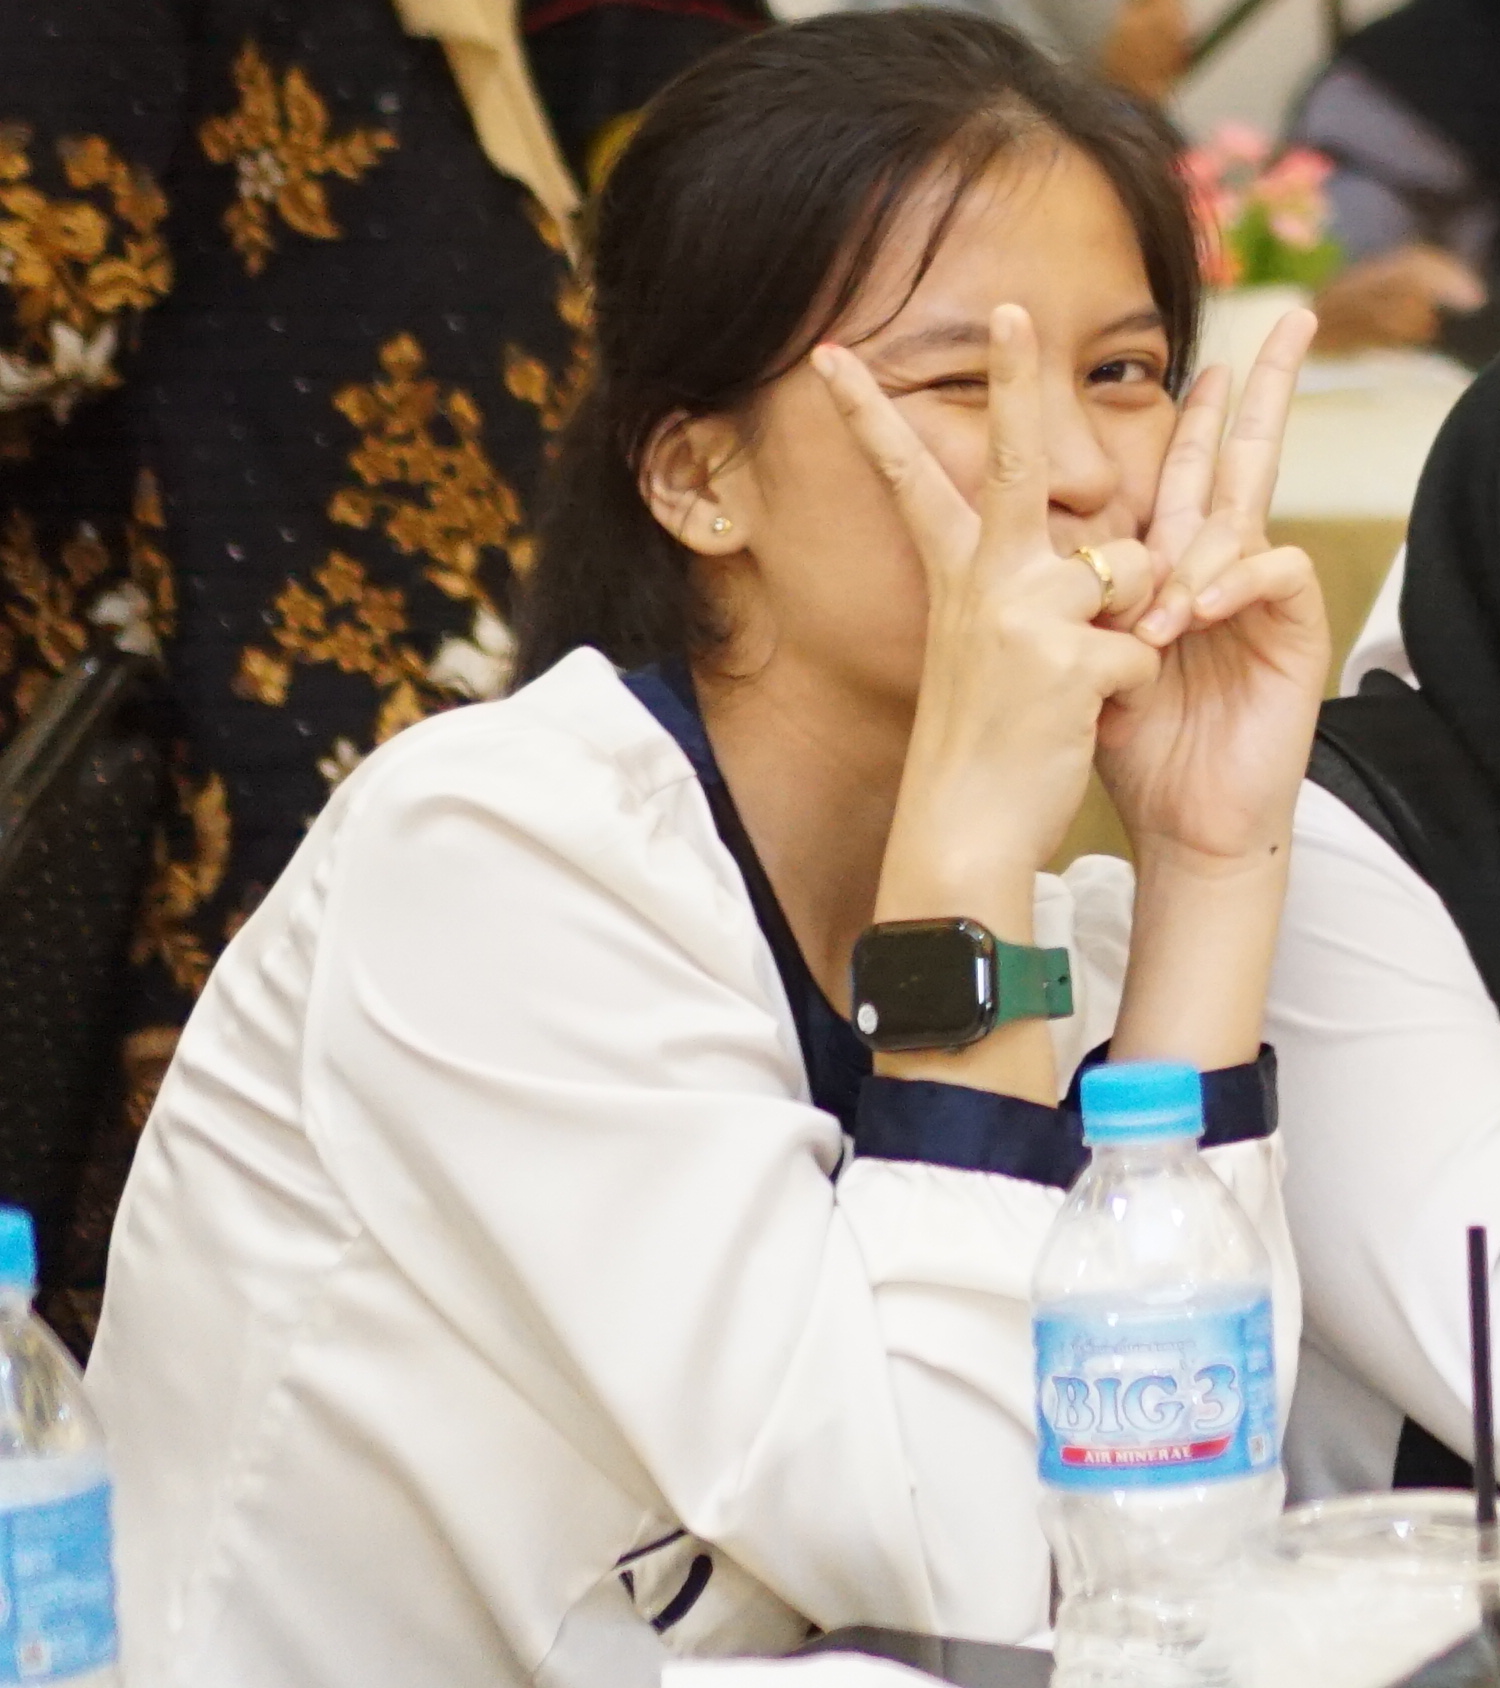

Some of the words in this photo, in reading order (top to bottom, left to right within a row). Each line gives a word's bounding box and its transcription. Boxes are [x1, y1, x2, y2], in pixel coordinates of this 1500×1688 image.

[1052, 1375, 1185, 1433] BIG
[1192, 1364, 1241, 1431] 3
[1084, 1450, 1111, 1464] AIR
[1115, 1446, 1193, 1464] MINERAL
